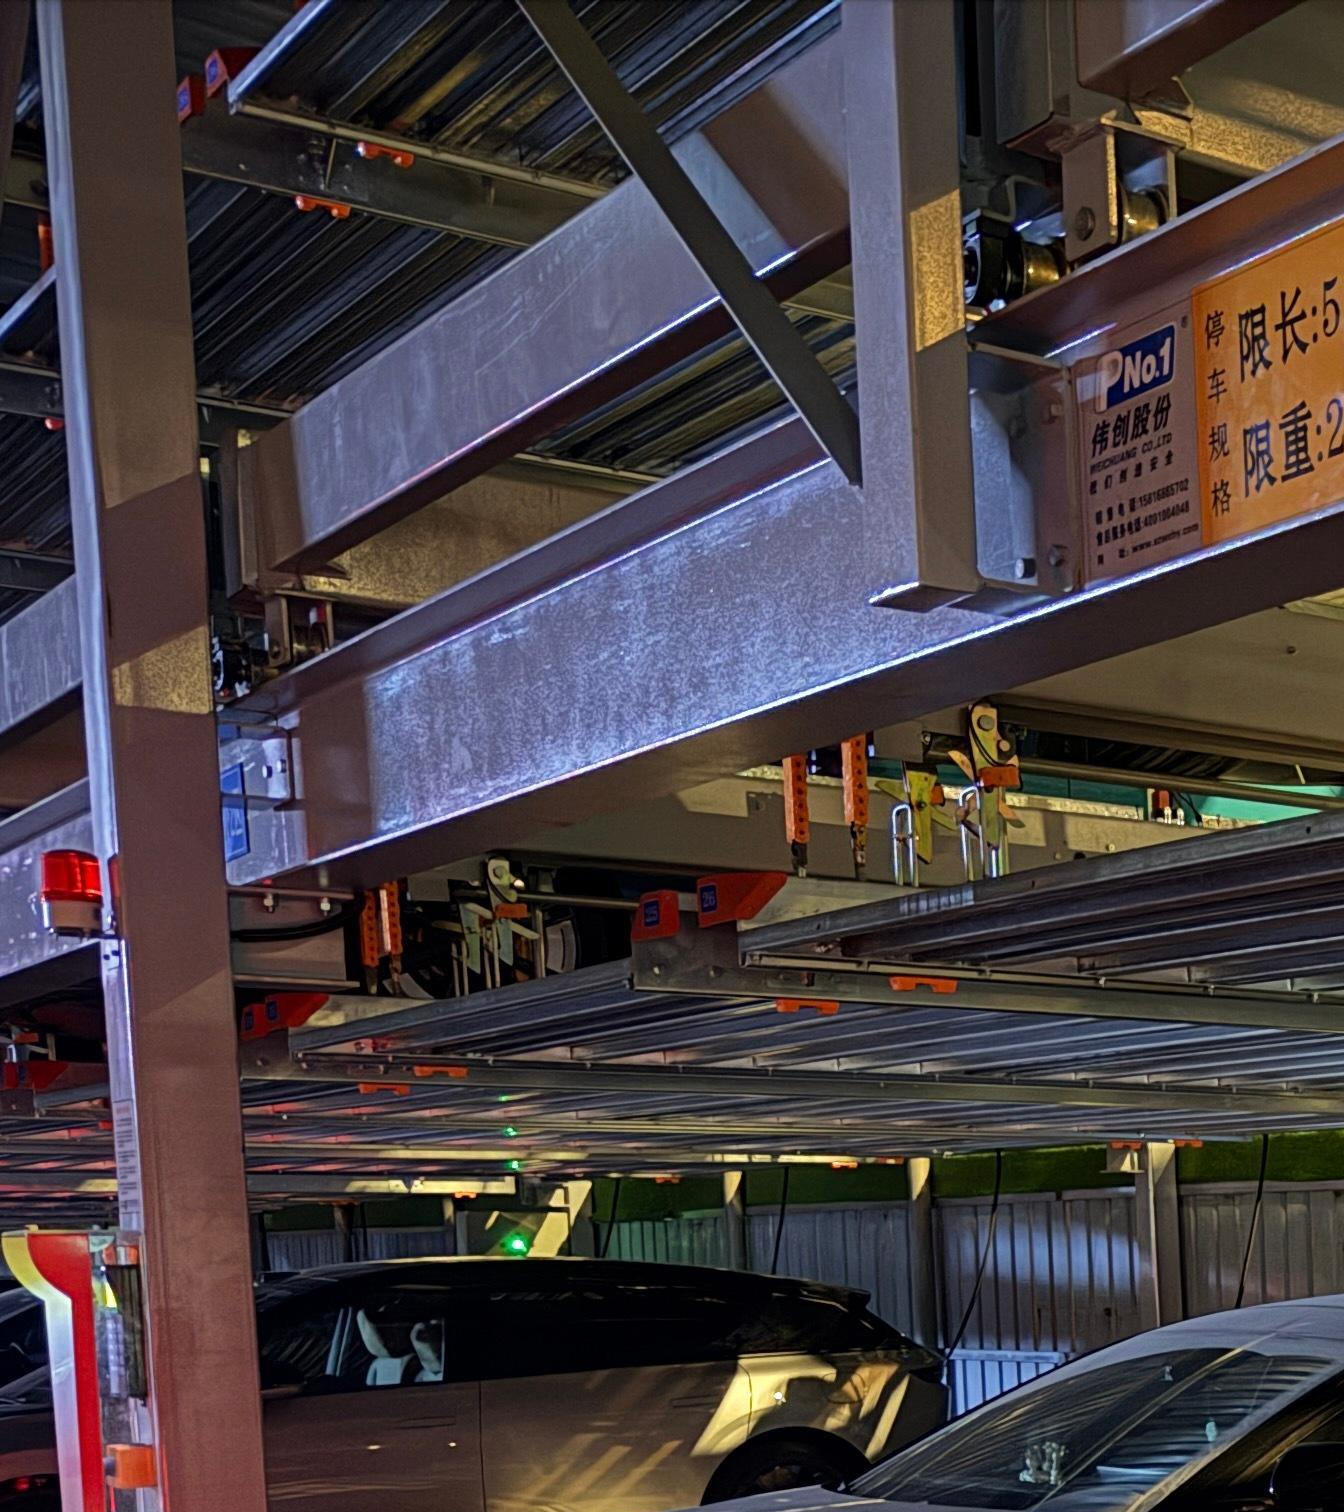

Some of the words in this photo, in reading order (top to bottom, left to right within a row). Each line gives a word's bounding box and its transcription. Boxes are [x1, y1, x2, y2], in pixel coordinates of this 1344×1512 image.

[1091, 391, 1171, 458] 伟创股份
[1204, 309, 1232, 518] 停车规格
